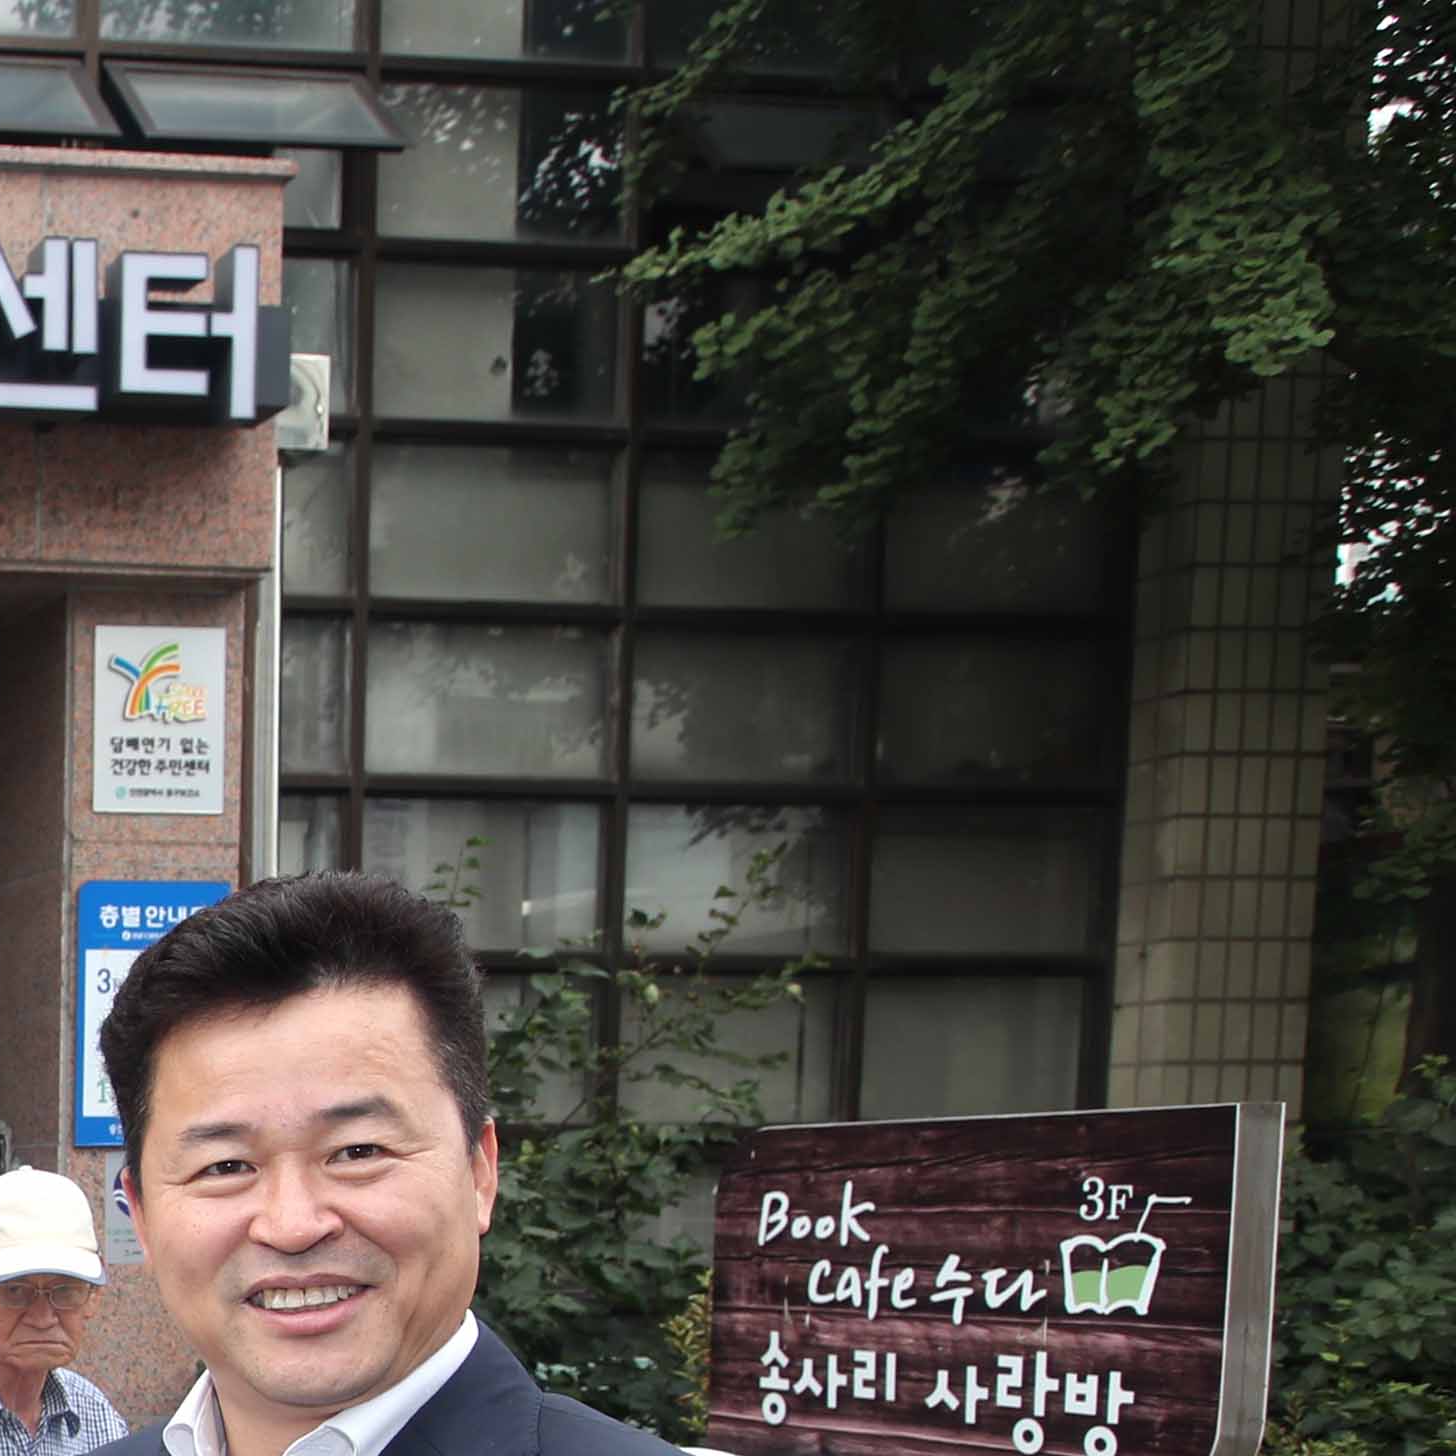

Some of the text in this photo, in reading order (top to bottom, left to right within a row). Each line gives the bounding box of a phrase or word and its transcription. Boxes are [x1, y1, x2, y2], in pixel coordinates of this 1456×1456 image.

[110, 736, 210, 755] 담배연기 없는
[111, 758, 211, 776] 건강한 주민센터
[99, 905, 141, 929] 층별
[757, 1181, 876, 1248] Book
[1079, 1176, 1134, 1222] 3F
[929, 1254, 1047, 1325] 수다
[759, 1331, 897, 1426] 송사리
